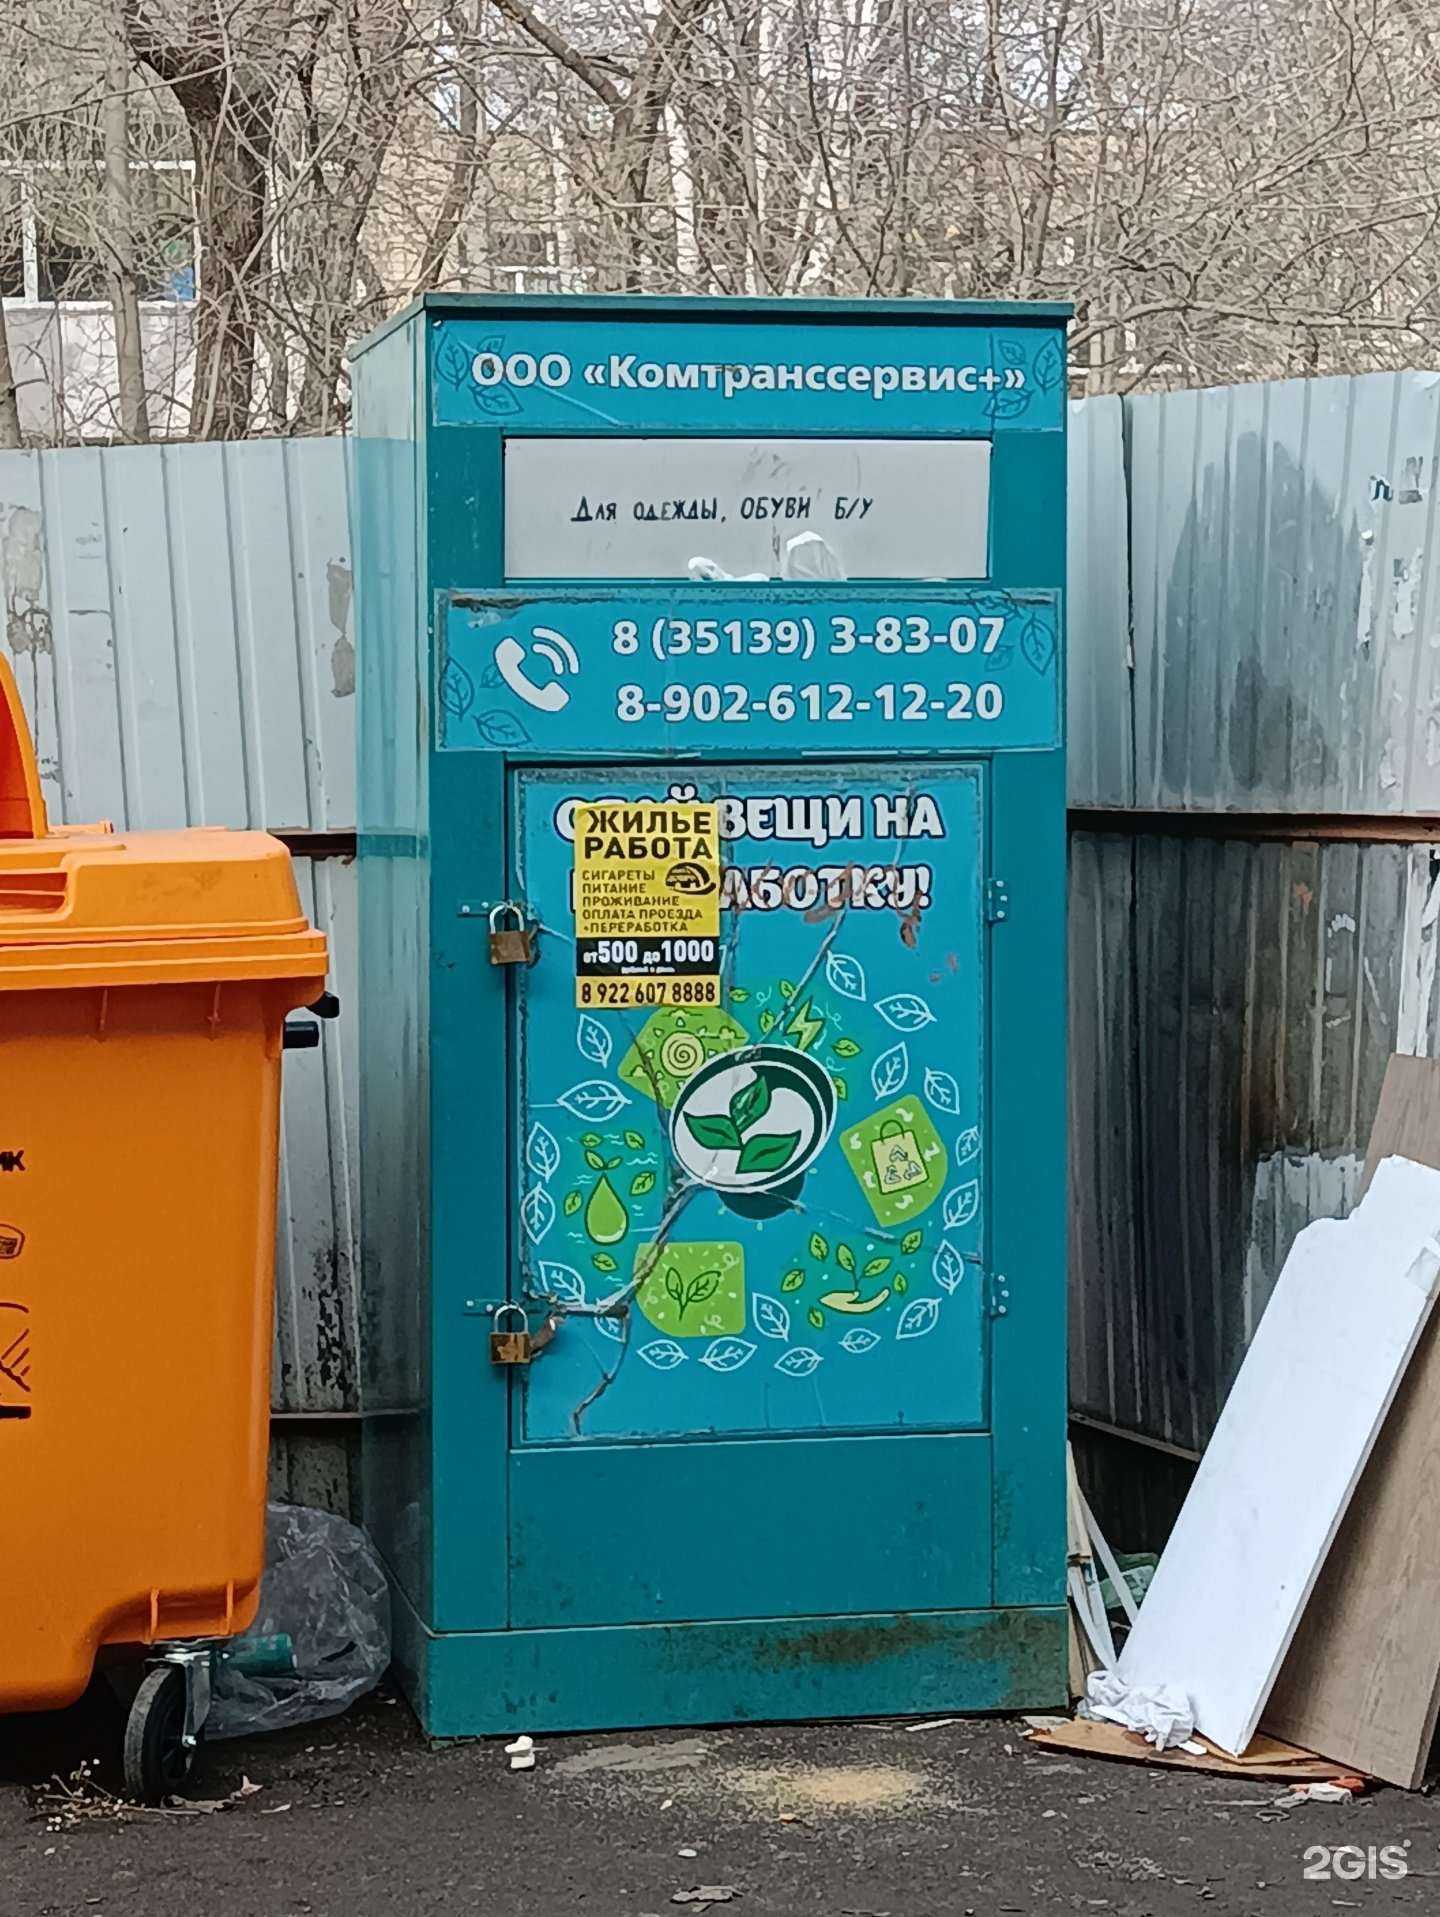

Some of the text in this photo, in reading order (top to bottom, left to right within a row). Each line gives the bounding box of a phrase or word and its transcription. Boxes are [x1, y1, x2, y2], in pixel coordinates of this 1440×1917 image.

[471, 352, 1026, 400] ООО «Комтранссервис+»
[632, 497, 727, 523] ОДЕЖДЫ,
[740, 496, 811, 520] ОБУВИ
[834, 497, 874, 520] Б/У
[612, 616, 1005, 661] 8 (35139) 3-83-07
[616, 683, 1003, 722] 8-902-612-12-20
[587, 810, 711, 834] ЖИЛЬЕ
[717, 795, 864, 848] ВЕЩИ
[872, 795, 945, 838] НА
[584, 836, 713, 860] РАБОТА
[582, 870, 655, 881] СИГАРЕТЫ
[582, 883, 647, 894] ПИТАНИЕ
[582, 895, 680, 907] ПРОЖИВАНИЕ
[582, 909, 703, 920] ОПЛАТА ПРОЕЗДА
[598, 940, 638, 963] 500
[661, 940, 714, 962] 1000
[582, 982, 715, 1003] 8 922 607 8888
